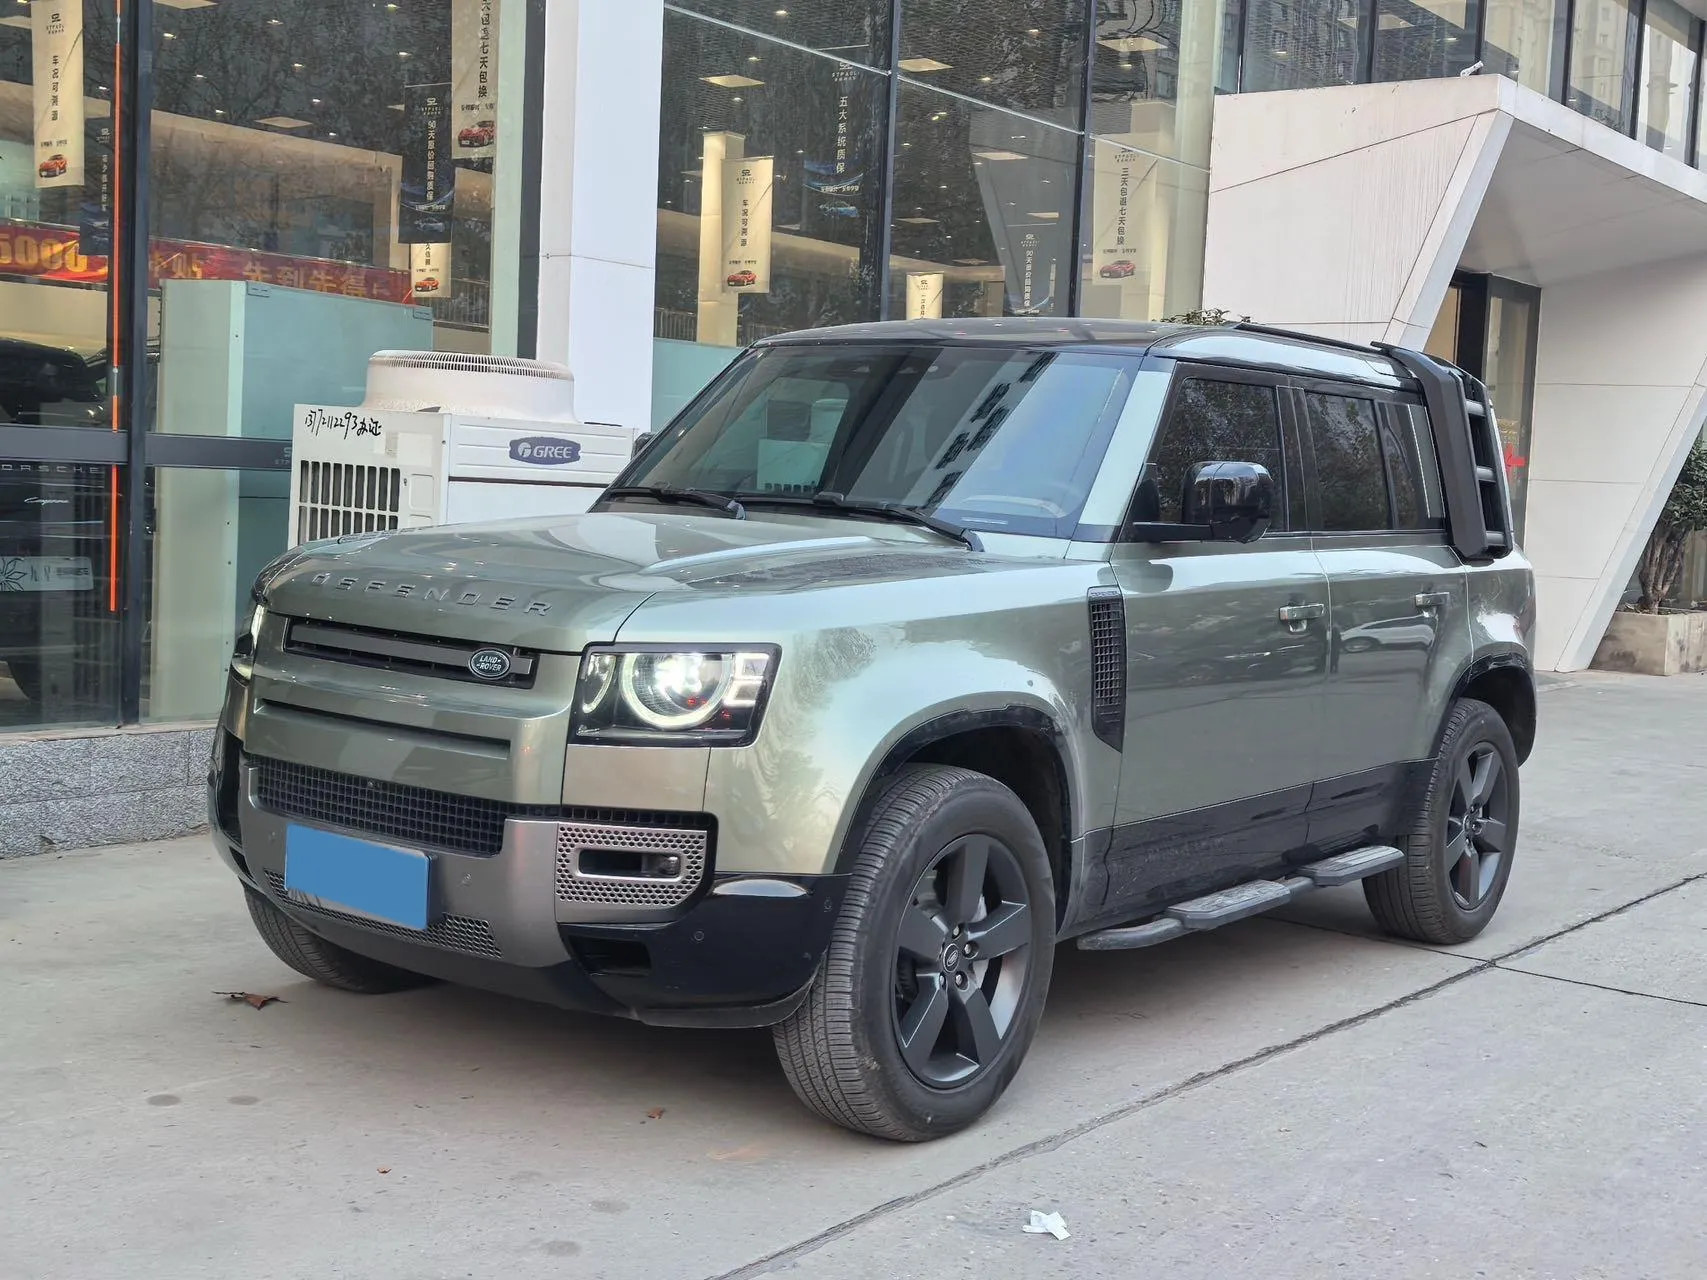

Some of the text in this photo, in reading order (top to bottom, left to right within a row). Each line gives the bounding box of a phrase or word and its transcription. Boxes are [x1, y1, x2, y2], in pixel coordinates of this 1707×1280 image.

[836, 96, 848, 174] 五大系统质保
[533, 445, 573, 459] GREE
[310, 572, 552, 617] DEFENDER
[479, 655, 498, 664] LAND
[480, 662, 502, 671] ROVER
